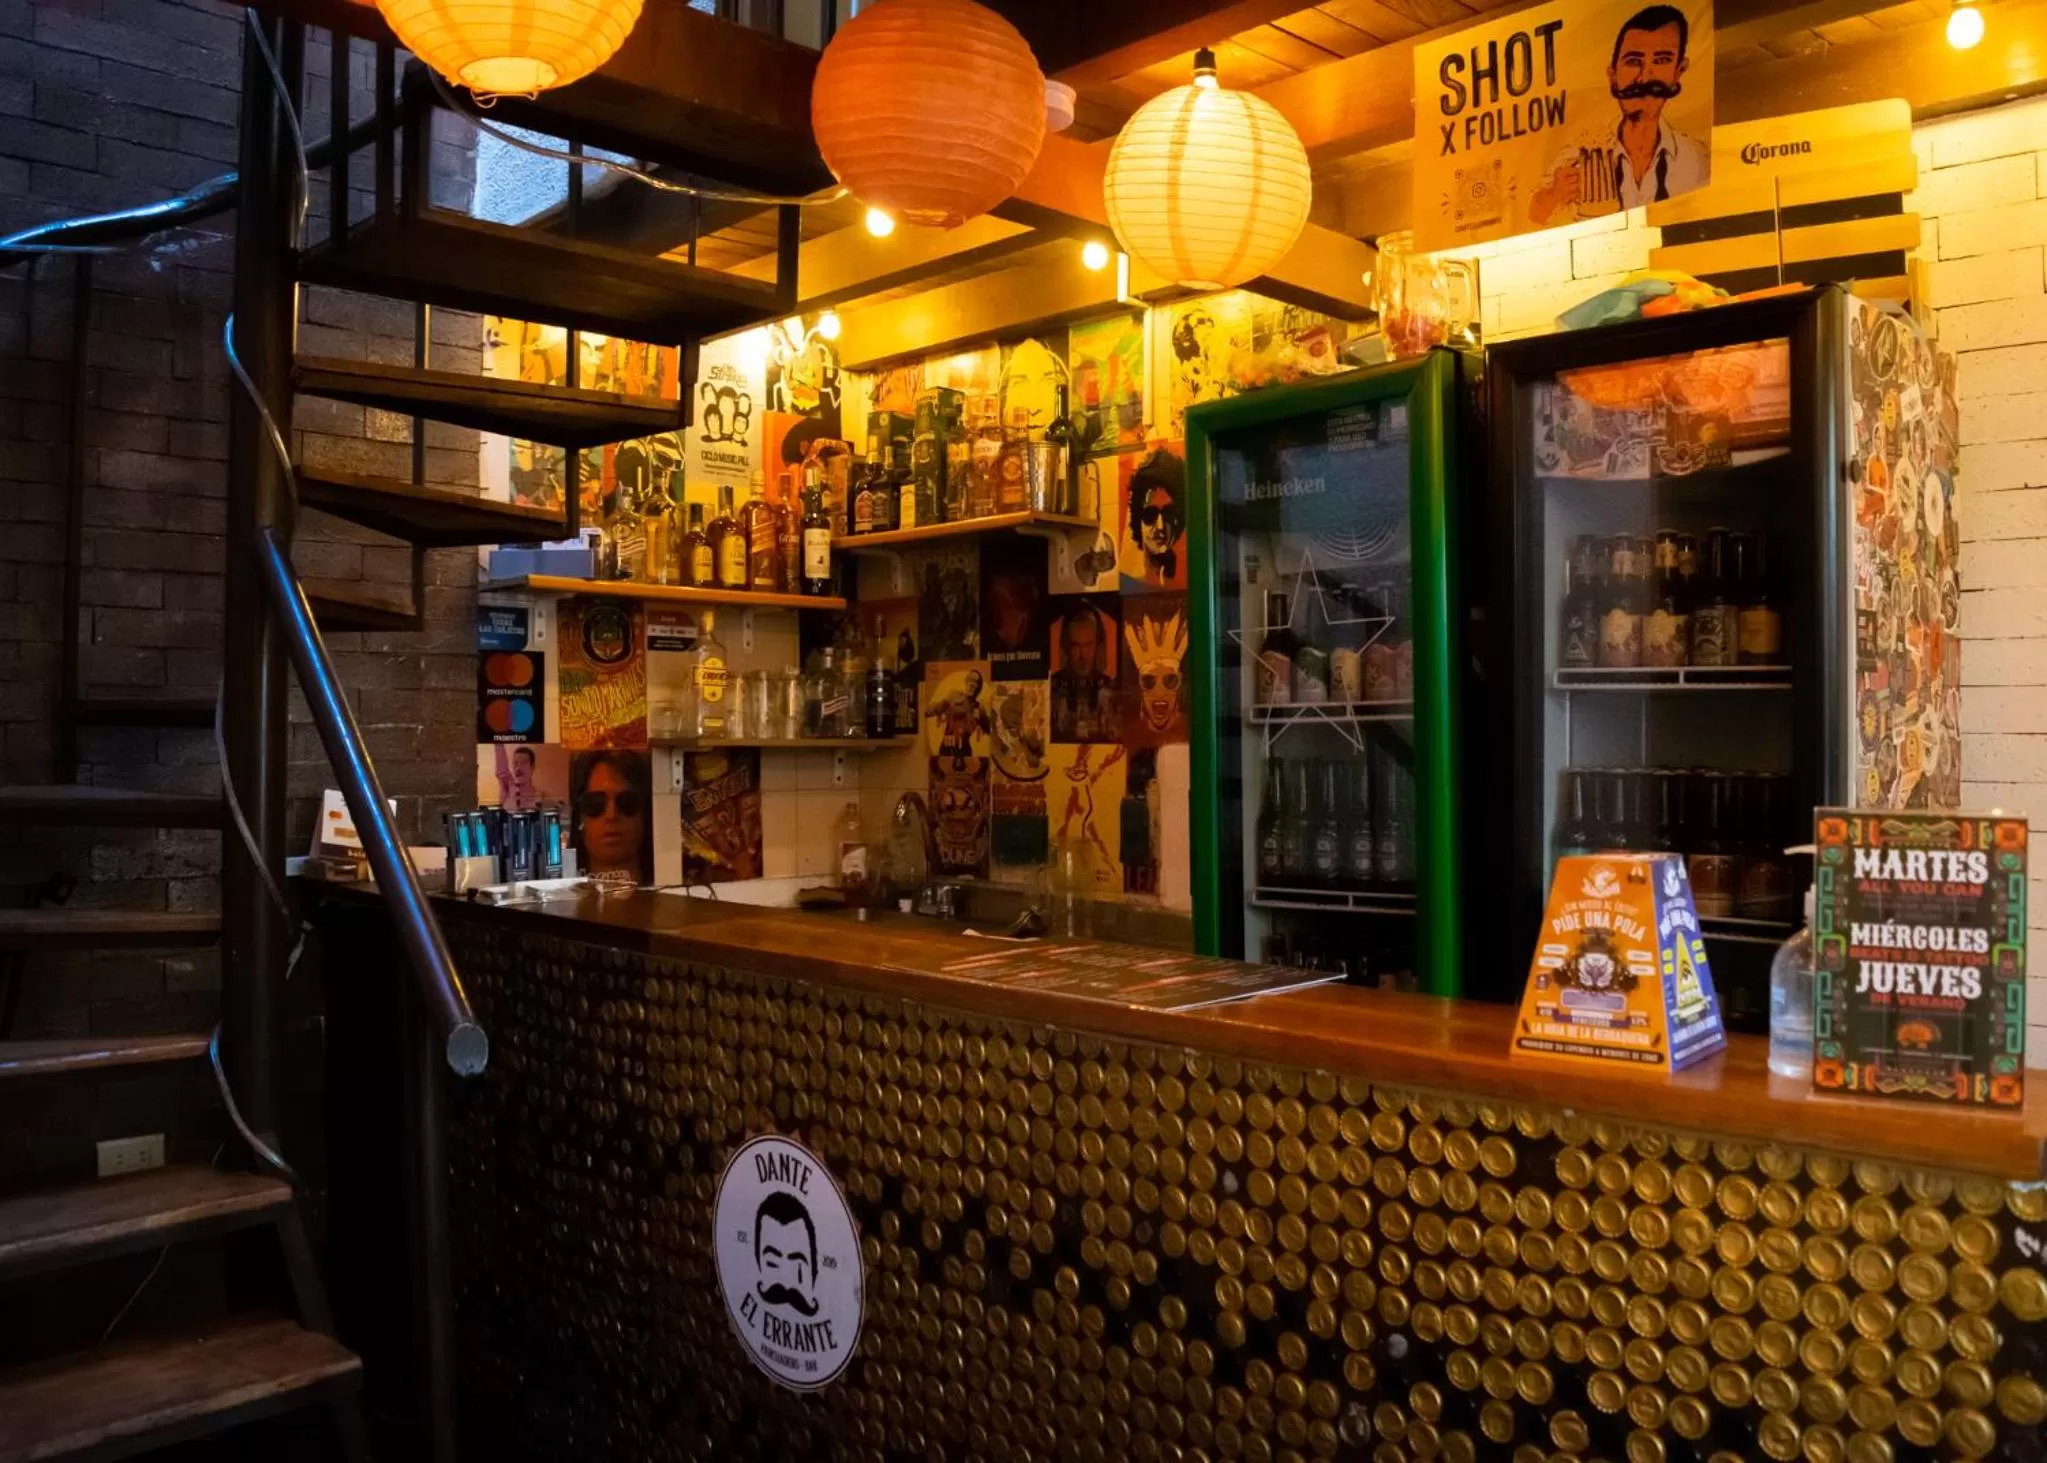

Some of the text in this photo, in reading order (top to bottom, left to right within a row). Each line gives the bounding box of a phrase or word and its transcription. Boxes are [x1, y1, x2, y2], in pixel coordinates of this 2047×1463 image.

[1439, 19, 1563, 116] SHOT
[1440, 89, 1567, 157] X FOLLOW
[1741, 141, 1811, 166] Corona
[1243, 477, 1326, 501] Heineken
[486, 688, 533, 696] mastercard
[493, 733, 528, 742] maestro
[1853, 847, 1989, 884] MARTES
[1859, 880, 1984, 897] ALL YOU CAN
[1552, 911, 1581, 935] PIDE
[1584, 911, 1610, 928] UNA
[1613, 914, 1647, 942] POLA
[1850, 918, 1989, 953] MIÉRCOLES
[1855, 960, 1982, 1000] JUEVES
[754, 1152, 813, 1196] DANTE
[740, 1292, 838, 1353] EL ERRANTE
